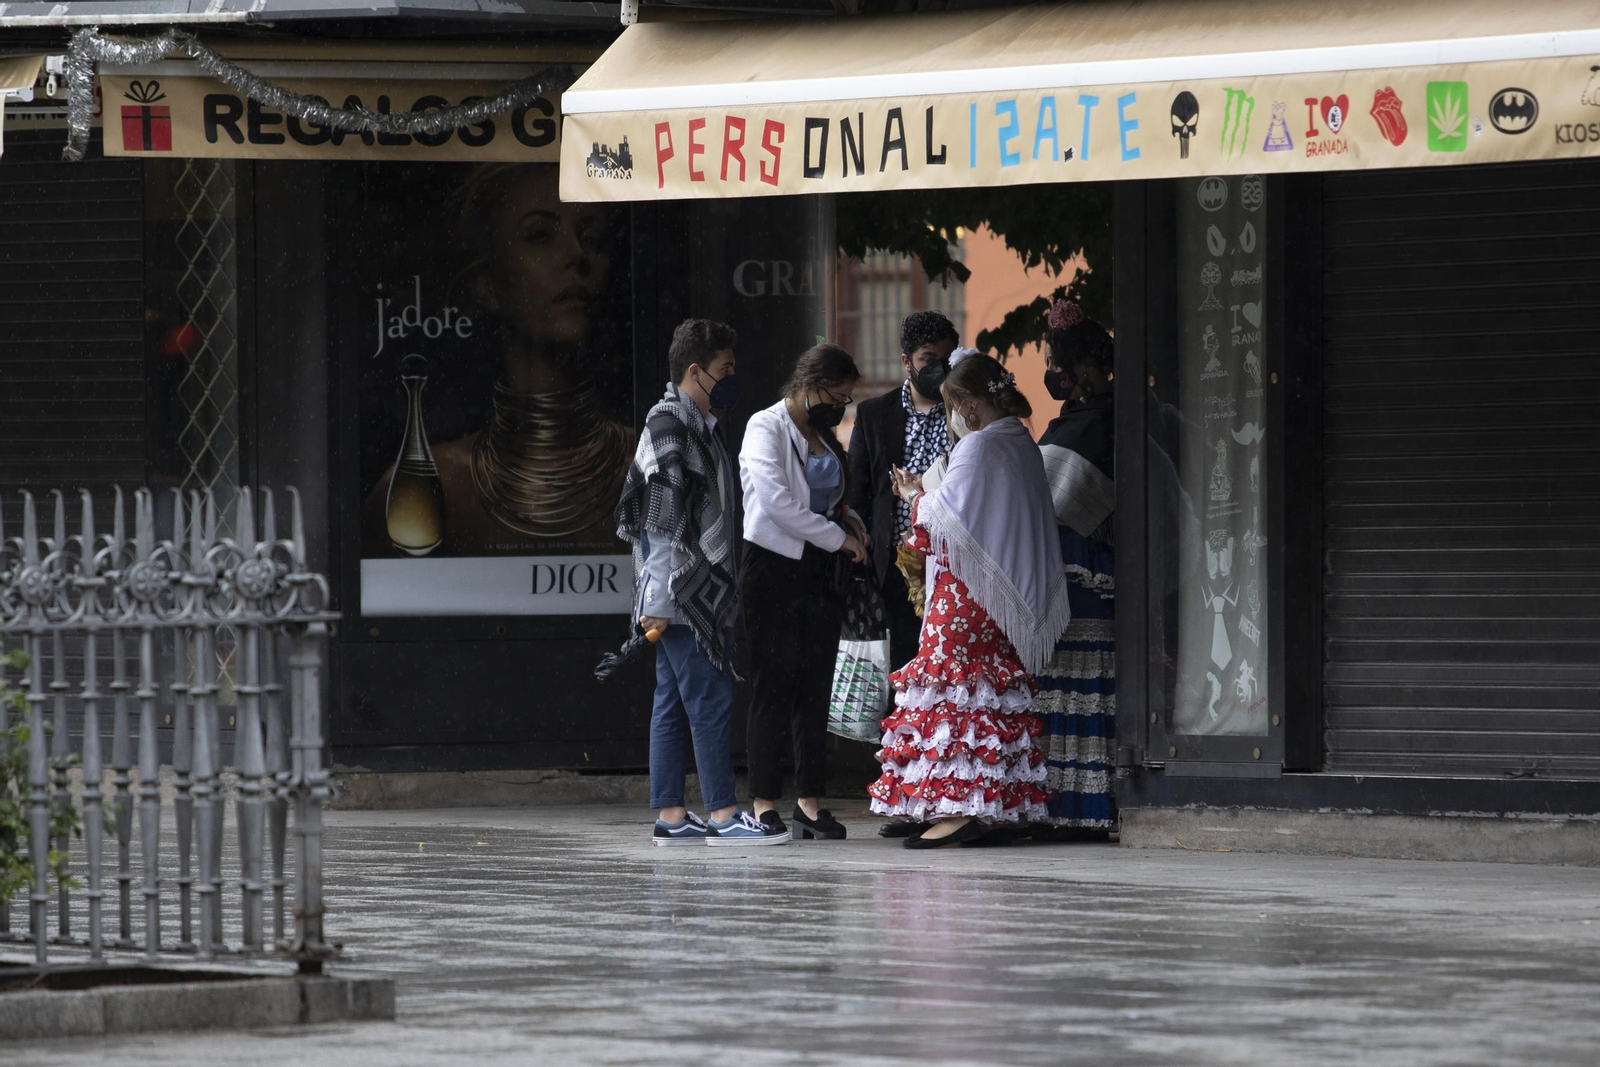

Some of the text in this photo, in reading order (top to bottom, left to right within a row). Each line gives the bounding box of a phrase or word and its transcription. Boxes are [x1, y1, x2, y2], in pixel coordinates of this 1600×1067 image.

[203, 93, 496, 147] REGALOS
[1555, 123, 1600, 145] KIOS
[1305, 138, 1349, 158] GRANADA
[373, 275, 473, 359] j'adore
[529, 562, 620, 595] DIOR
